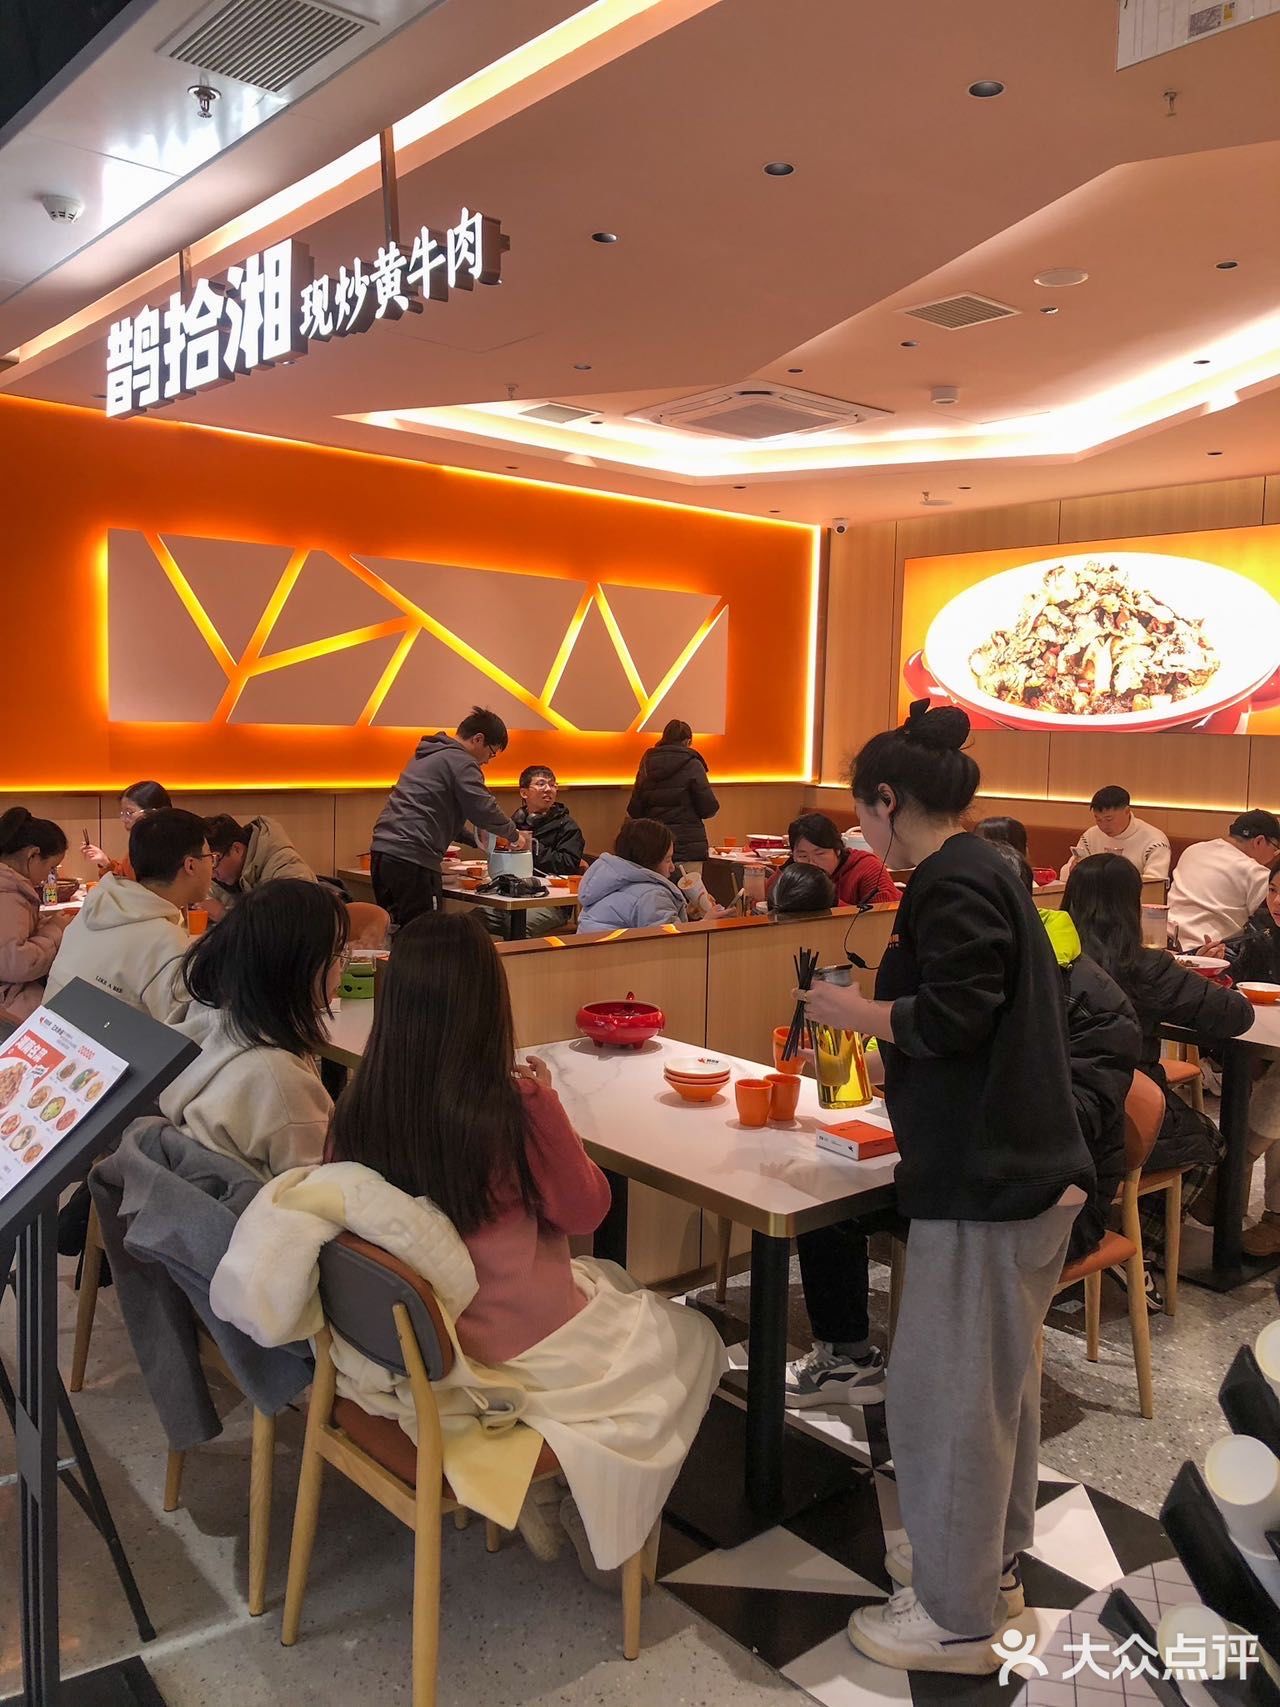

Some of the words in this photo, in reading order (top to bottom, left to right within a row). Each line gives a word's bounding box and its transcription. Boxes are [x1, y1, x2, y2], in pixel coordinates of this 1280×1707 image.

[107, 238, 292, 417] 鹊拾湘
[299, 207, 483, 338] 现炒黄牛肉
